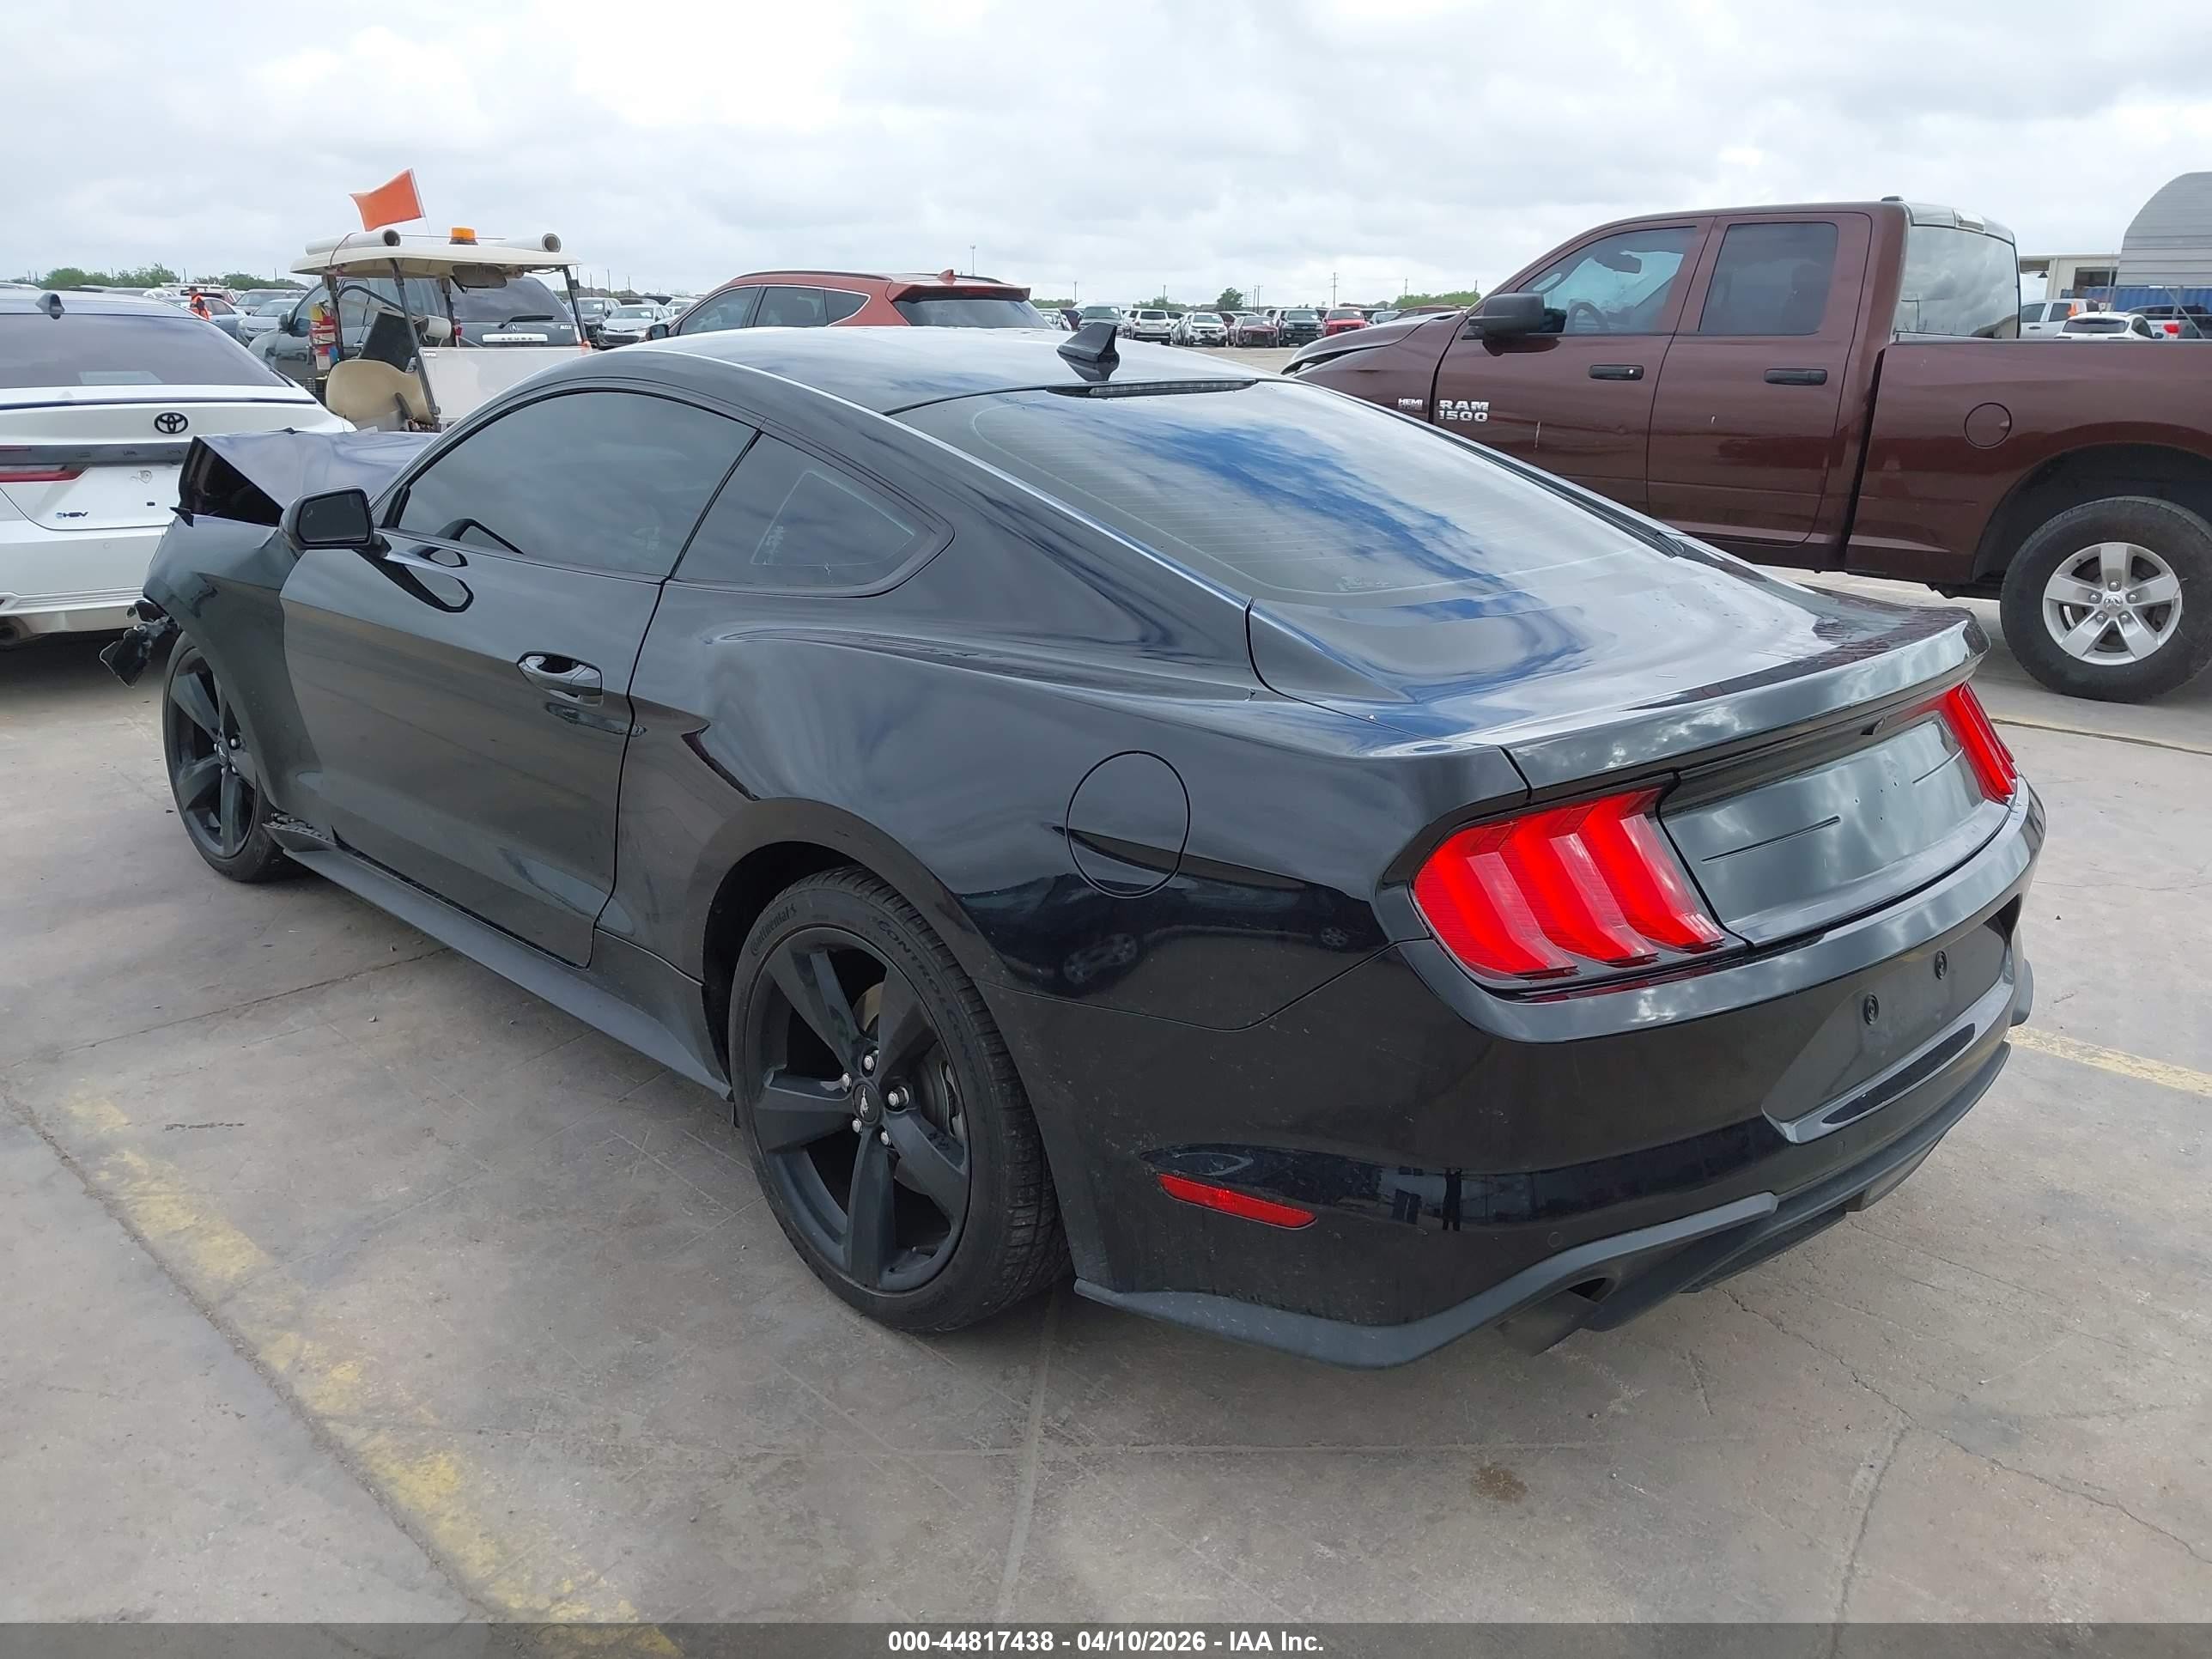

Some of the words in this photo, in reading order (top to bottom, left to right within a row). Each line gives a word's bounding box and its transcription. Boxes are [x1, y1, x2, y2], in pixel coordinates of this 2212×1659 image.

[1398, 398, 1423, 406] HEMI
[1439, 399, 1490, 411] RAM
[1439, 410, 1488, 422] 1500
[750, 906, 791, 957] Continental
